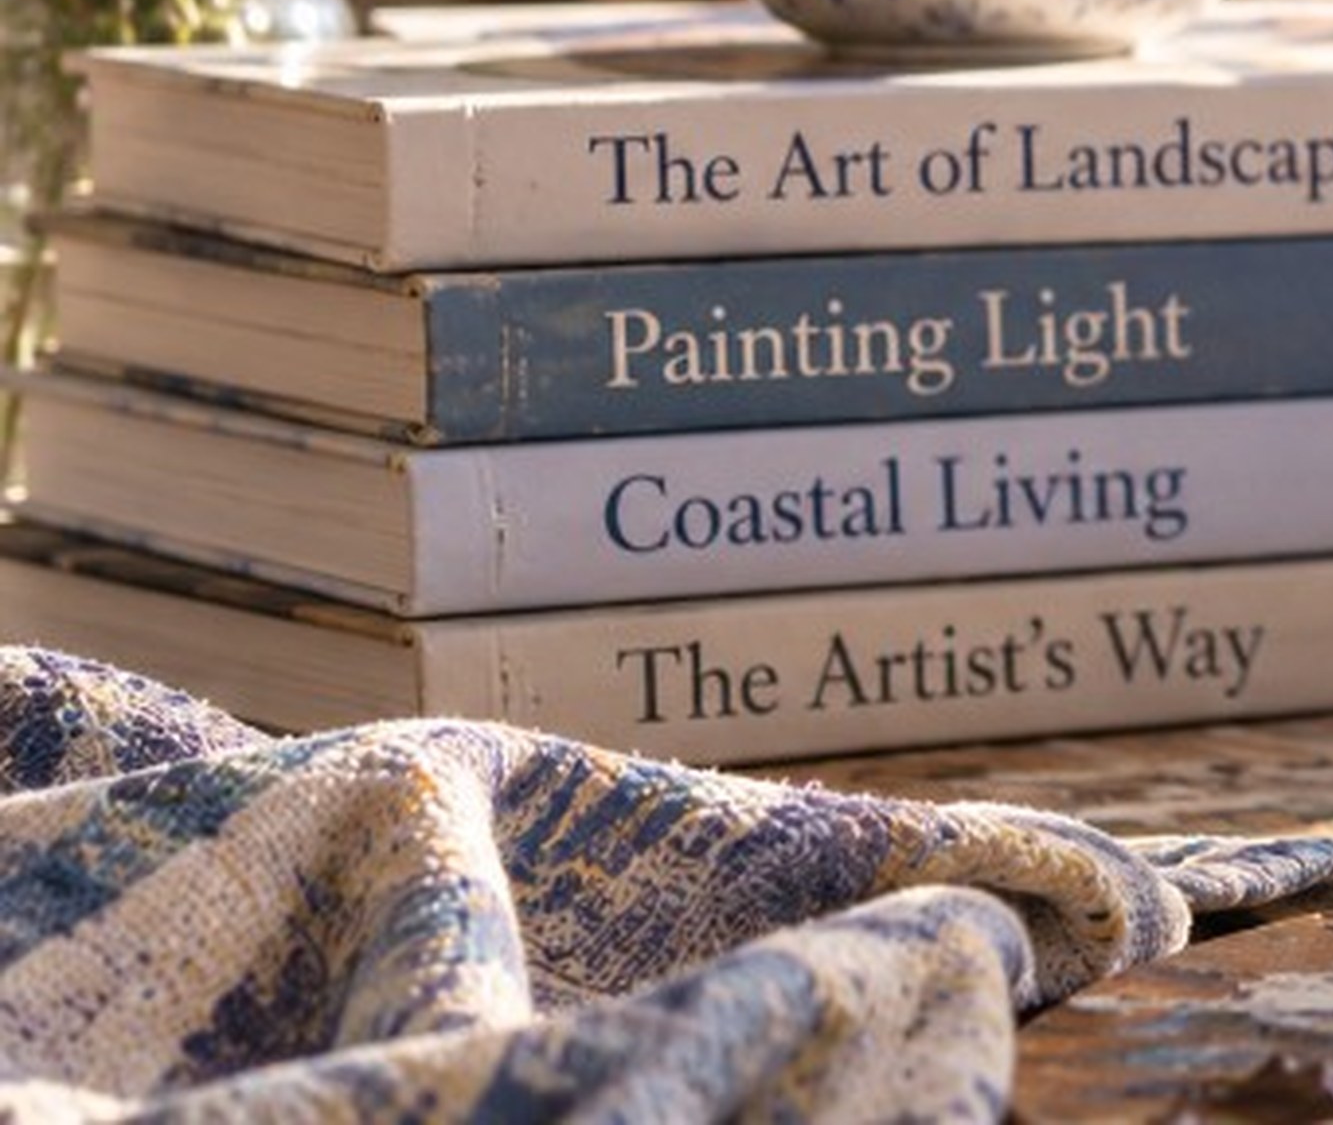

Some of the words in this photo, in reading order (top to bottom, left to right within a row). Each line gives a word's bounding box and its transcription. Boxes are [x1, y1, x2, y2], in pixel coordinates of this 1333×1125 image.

[588, 133, 740, 205] The
[766, 130, 892, 201] Art
[919, 122, 997, 193] of
[603, 299, 953, 395] Painting
[977, 281, 1193, 383] Light
[602, 458, 907, 554] Coastal
[936, 450, 1190, 541] Living
[616, 643, 780, 724] The
[1099, 606, 1267, 696] Way
